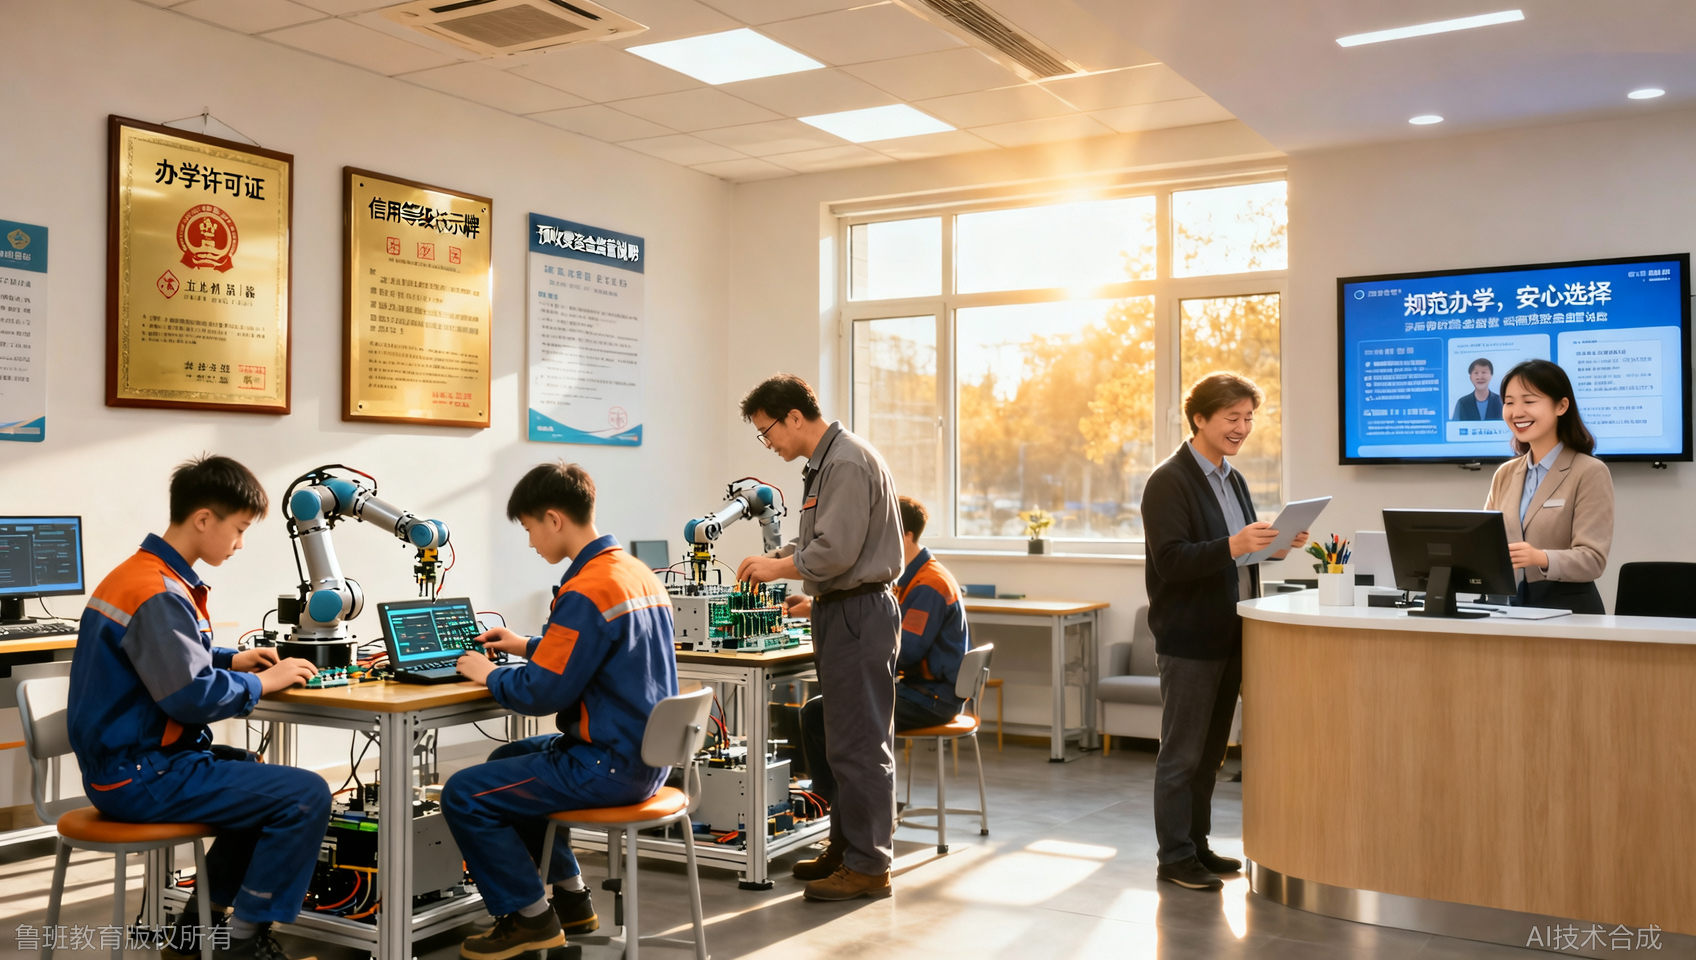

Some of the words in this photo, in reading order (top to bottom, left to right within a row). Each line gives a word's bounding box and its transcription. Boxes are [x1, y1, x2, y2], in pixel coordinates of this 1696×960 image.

[155, 159, 265, 201] 办学许可证
[1403, 281, 1612, 317] 规范办学，安心选择
